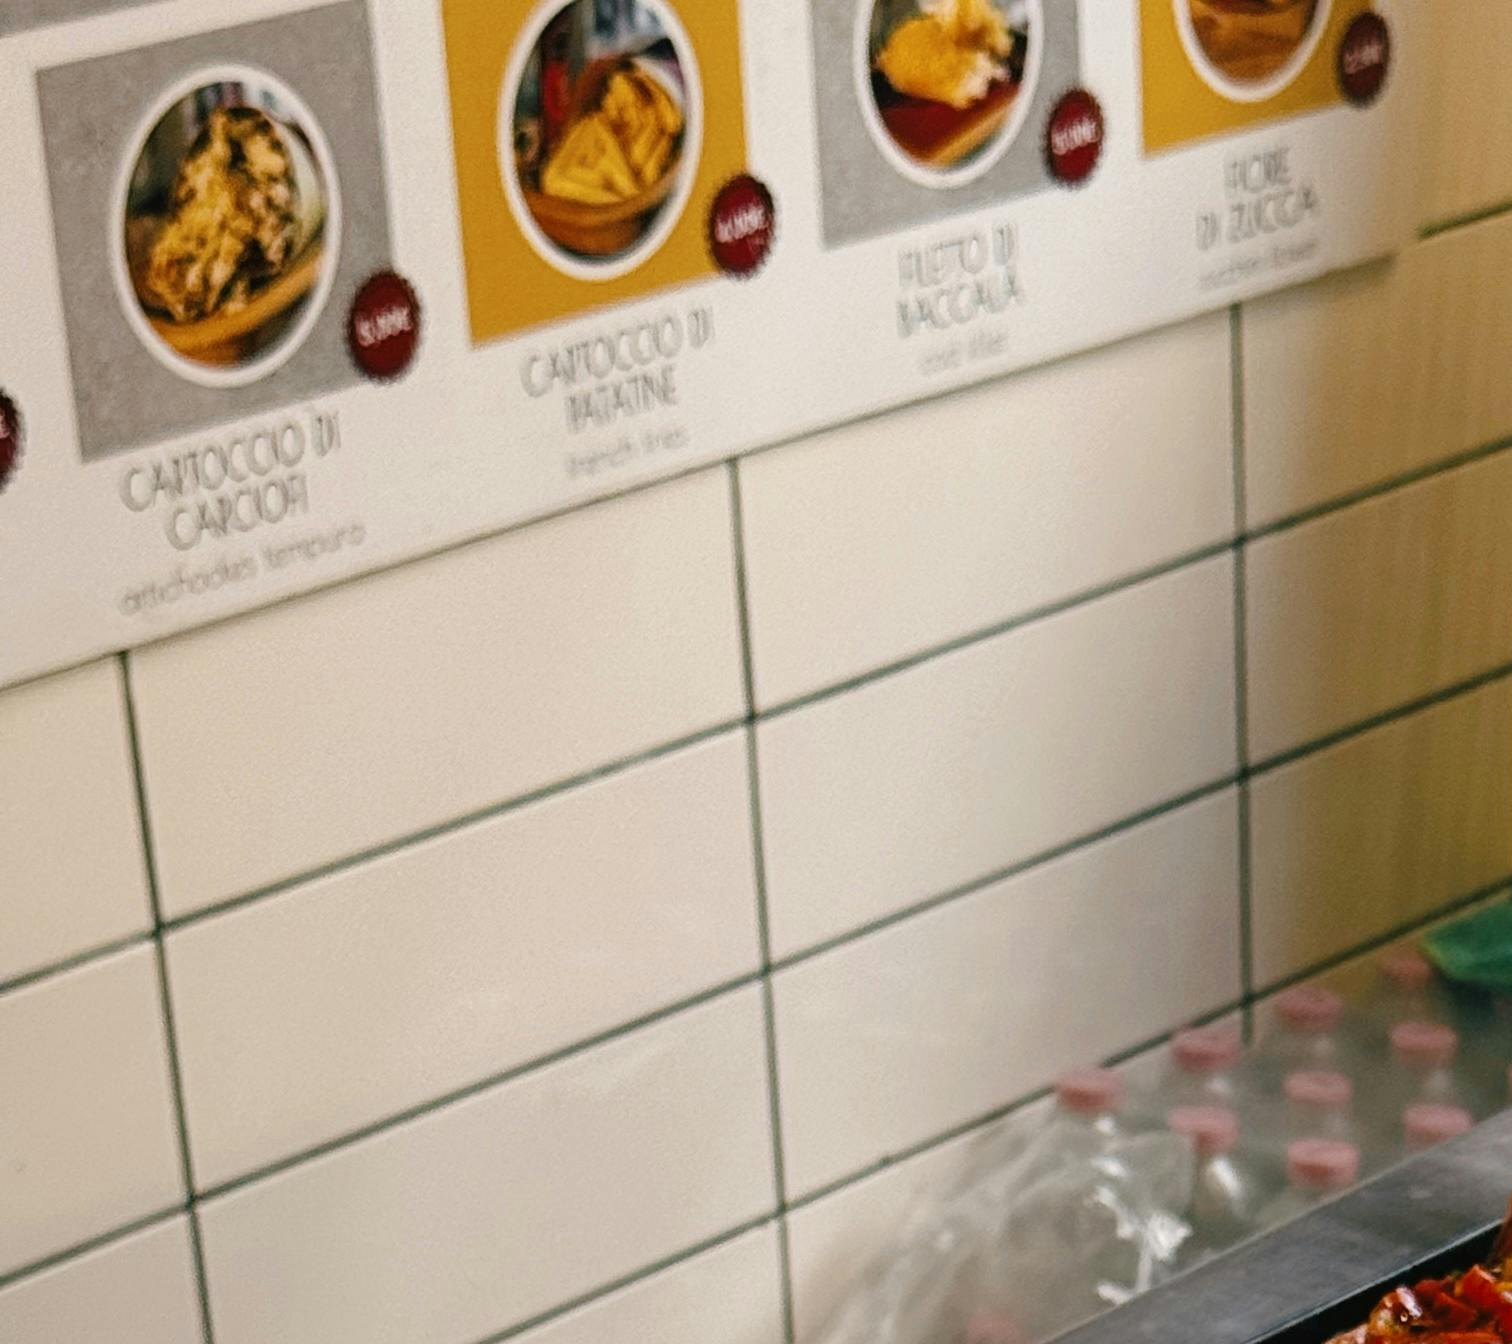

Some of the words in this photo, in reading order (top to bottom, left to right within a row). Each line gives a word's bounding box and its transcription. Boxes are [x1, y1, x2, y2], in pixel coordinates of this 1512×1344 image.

[519, 310, 684, 399] CARTOCCIO
[687, 303, 716, 350] DI
[119, 419, 306, 513] CARTOCCIO
[310, 409, 342, 458] DI
[163, 472, 309, 552] CARCIOFI
